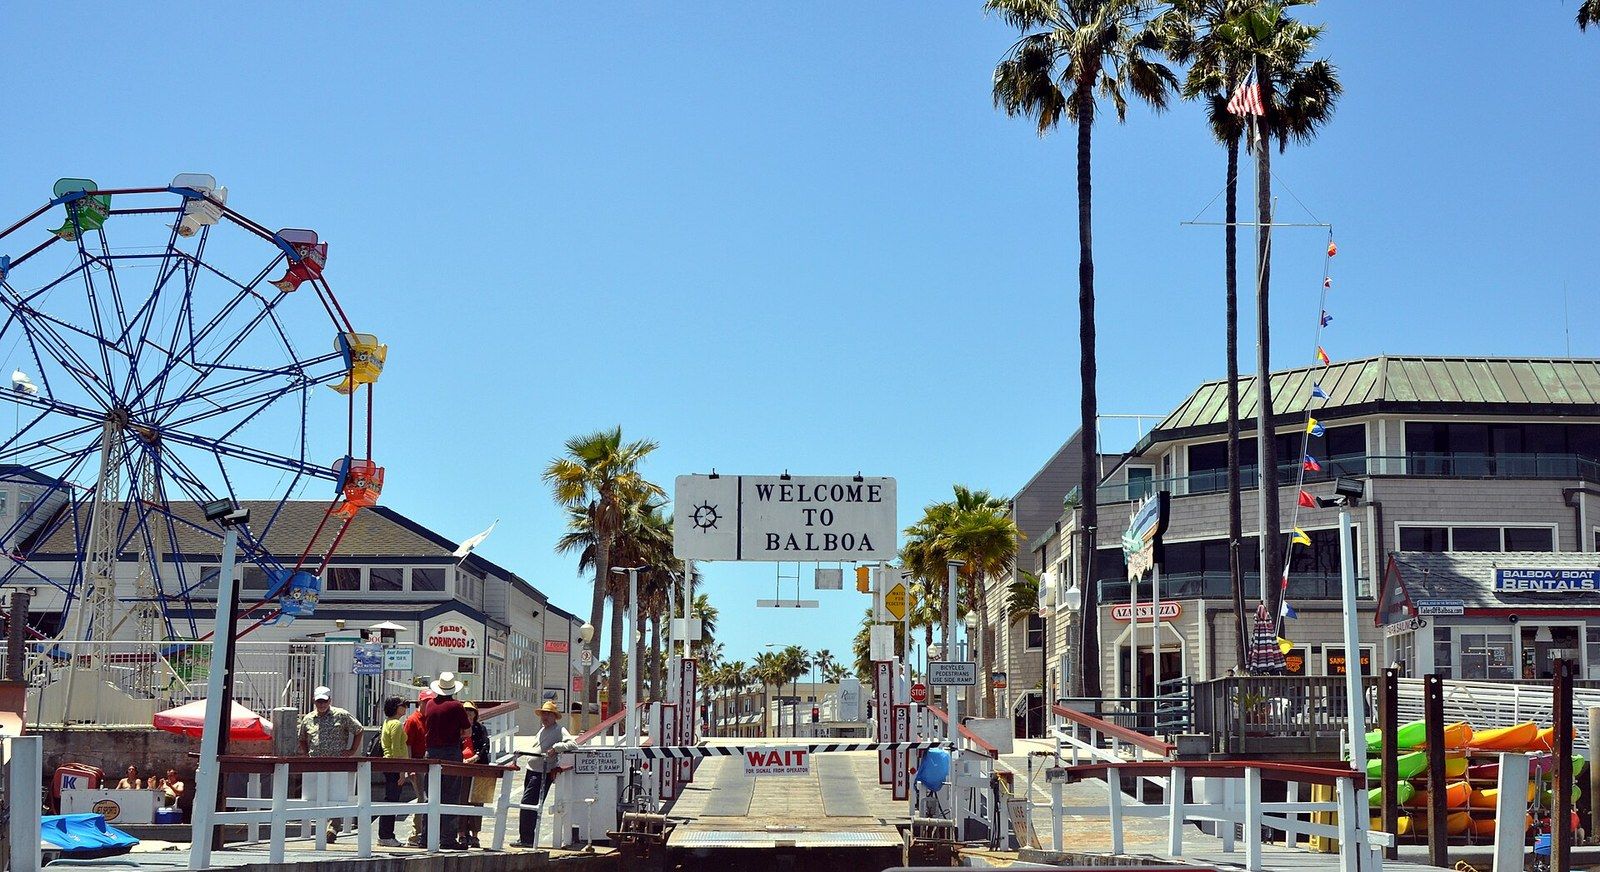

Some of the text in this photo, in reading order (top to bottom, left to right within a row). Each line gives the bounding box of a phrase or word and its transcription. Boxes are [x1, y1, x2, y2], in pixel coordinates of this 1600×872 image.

[755, 484, 882, 503] WELCOME
[802, 508, 834, 527] TO
[765, 532, 875, 551] BALBOA
[1502, 570, 1553, 578] BALBOA
[1561, 571, 1595, 579] BOAT
[1502, 578, 1595, 590] RENTALS
[438, 625, 467, 636] Jane's
[428, 636, 466, 648] CORNDOGS
[686, 661, 692, 670] 3
[1329, 657, 1369, 665] SANDES
[881, 664, 887, 672] 3
[911, 688, 926, 697] STOP
[898, 708, 905, 717] 3
[746, 750, 807, 767] WAIT
